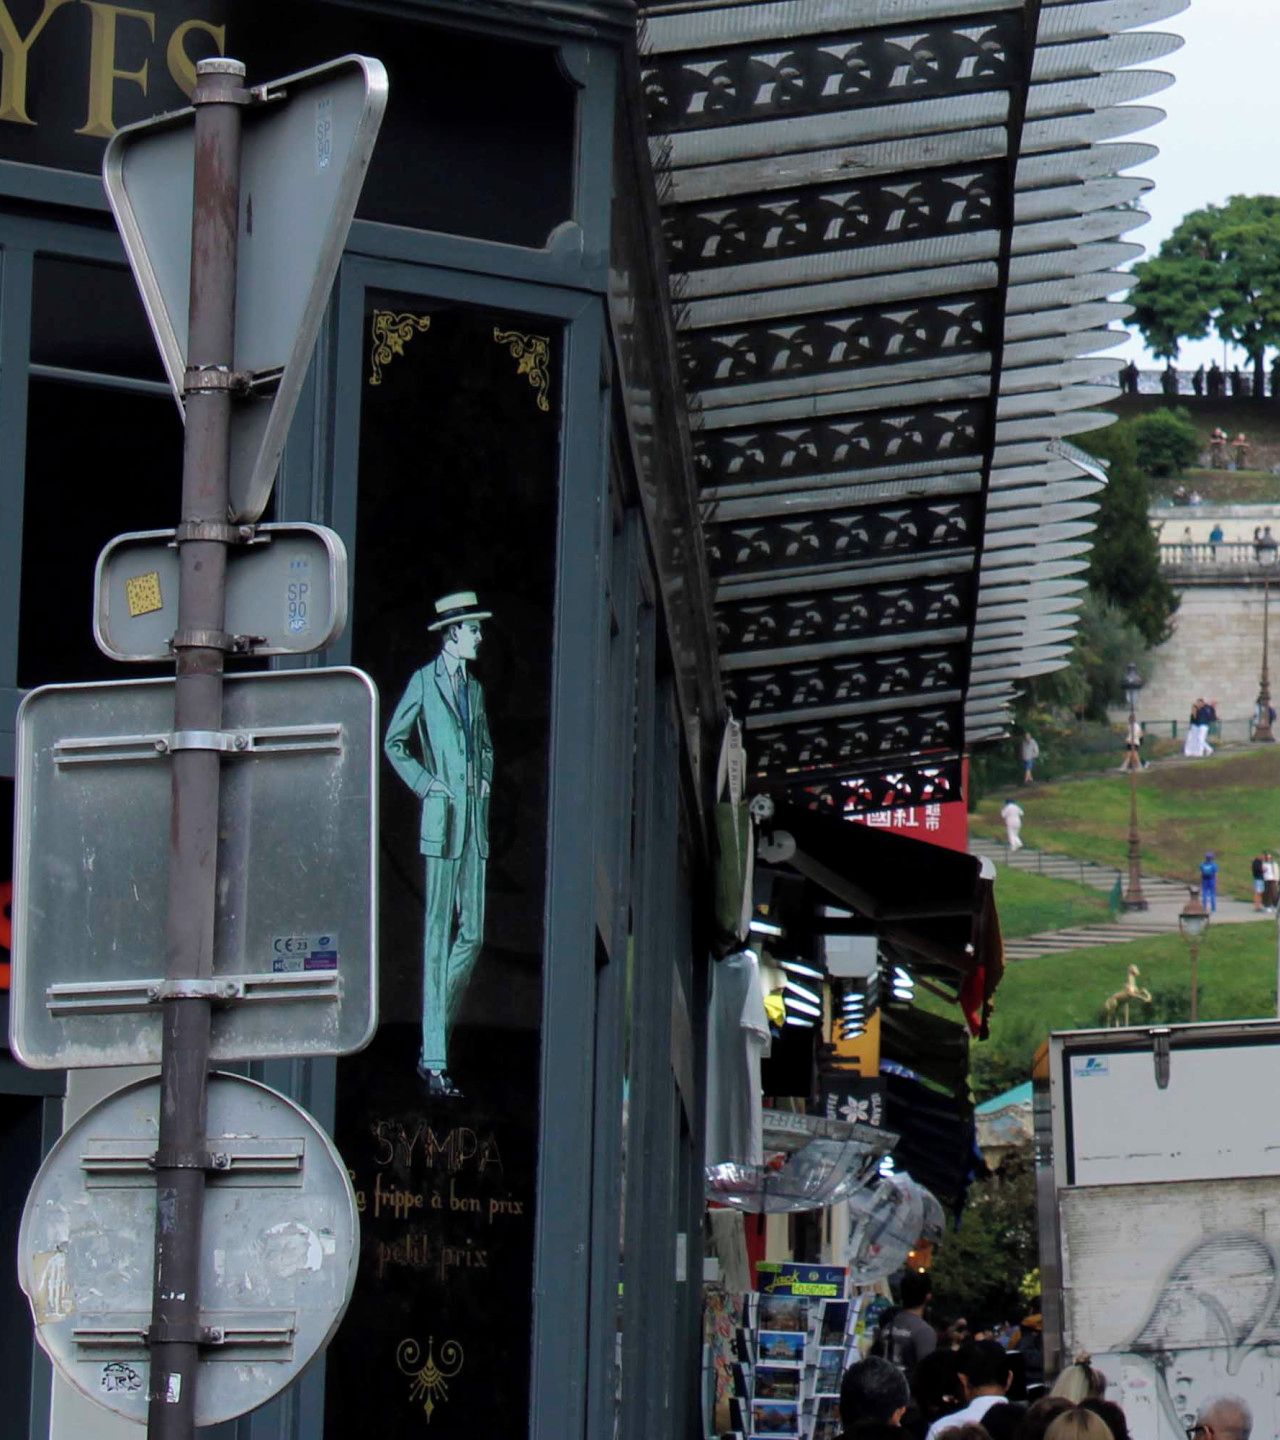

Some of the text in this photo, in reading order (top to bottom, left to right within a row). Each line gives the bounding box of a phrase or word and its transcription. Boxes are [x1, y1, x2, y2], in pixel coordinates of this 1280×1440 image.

[288, 583, 308, 601] SP
[288, 601, 307, 618] 90
[374, 1120, 504, 1177] SYMPA
[374, 1172, 424, 1219] frippe
[449, 1177, 481, 1212] bon
[489, 1192, 524, 1225] prix
